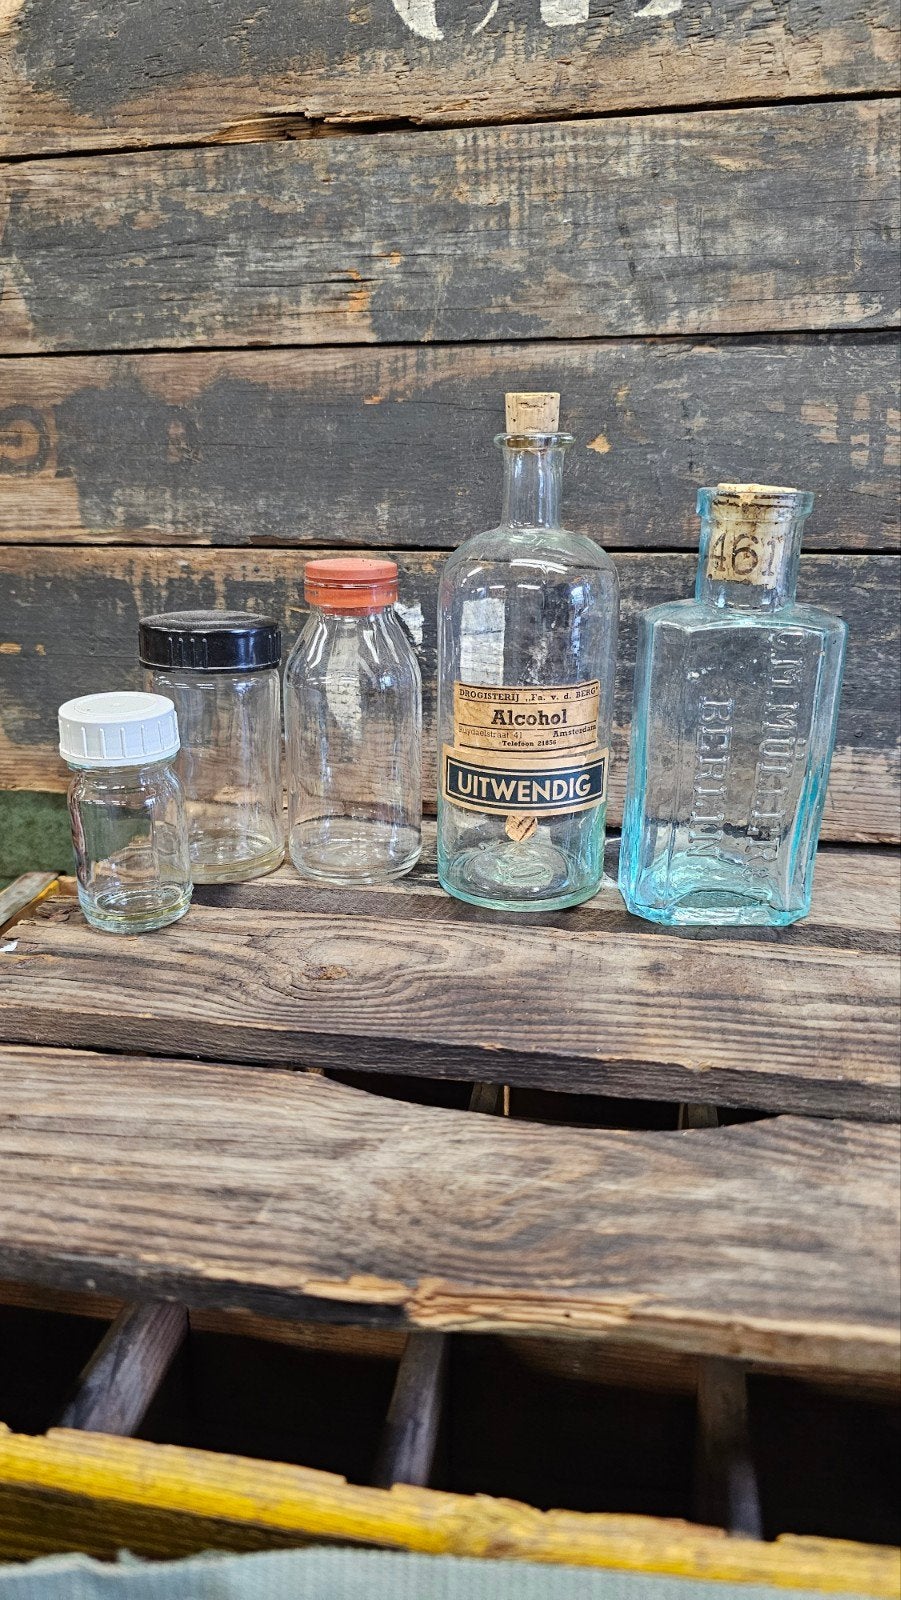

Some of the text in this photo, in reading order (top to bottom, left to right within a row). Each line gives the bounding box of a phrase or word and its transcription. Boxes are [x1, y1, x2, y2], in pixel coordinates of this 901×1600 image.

[458, 688, 520, 702] DROGISTERIJ
[563, 692, 572, 700] d.
[491, 709, 568, 726] Alcohol
[553, 725, 597, 738] Amsterdam
[687, 696, 733, 858] BERLIN
[457, 770, 592, 802] UITWENDIG
